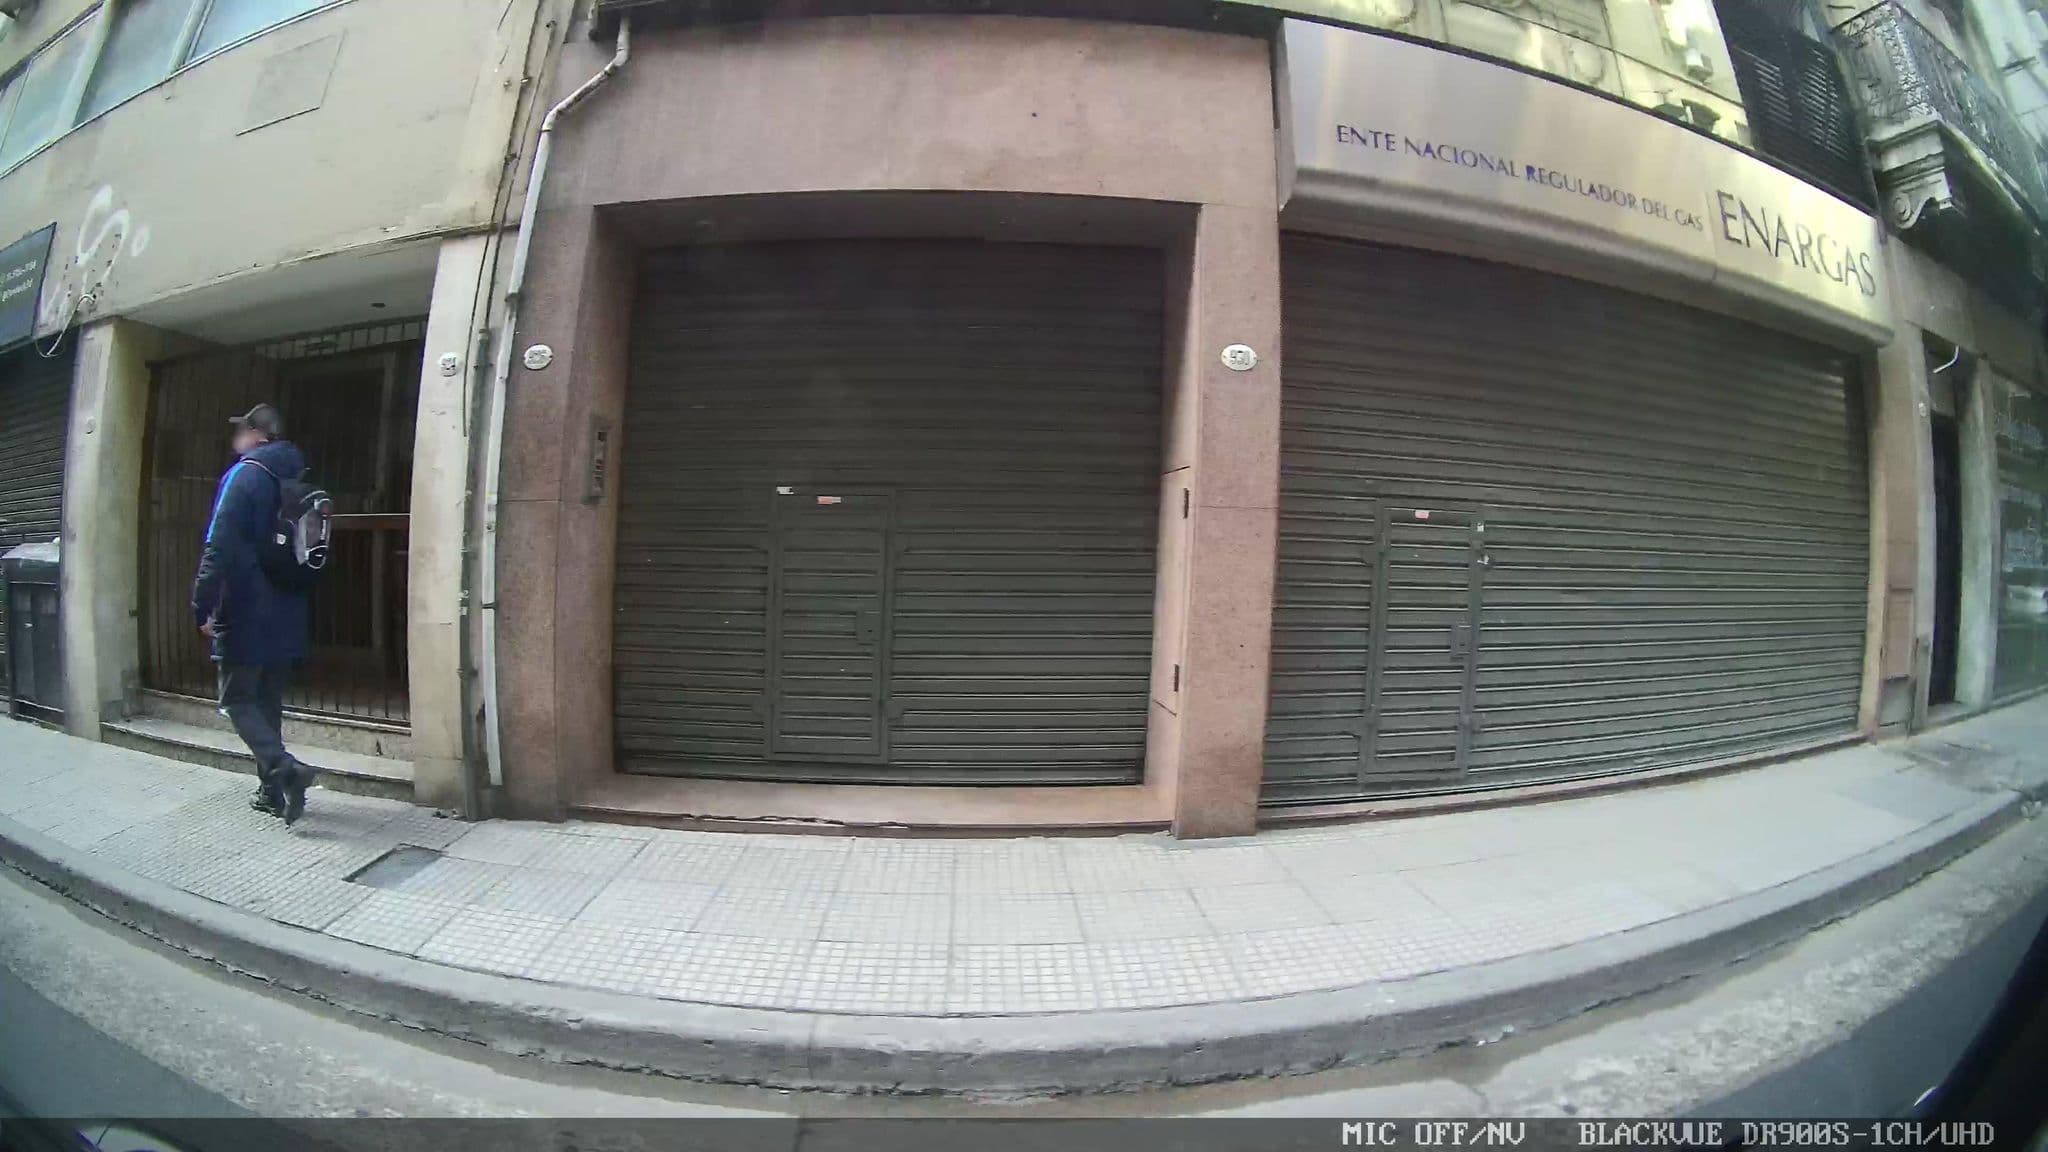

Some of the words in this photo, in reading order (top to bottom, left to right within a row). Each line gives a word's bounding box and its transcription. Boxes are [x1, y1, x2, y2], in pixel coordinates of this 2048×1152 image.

[1336, 124, 1396, 152] ENTE
[1404, 136, 1520, 178] NACIONAL
[1525, 164, 1637, 209] REGULADOR
[1642, 198, 1671, 221] DEL
[1674, 208, 1705, 232] GAS
[1717, 189, 1877, 297] ENARGAS
